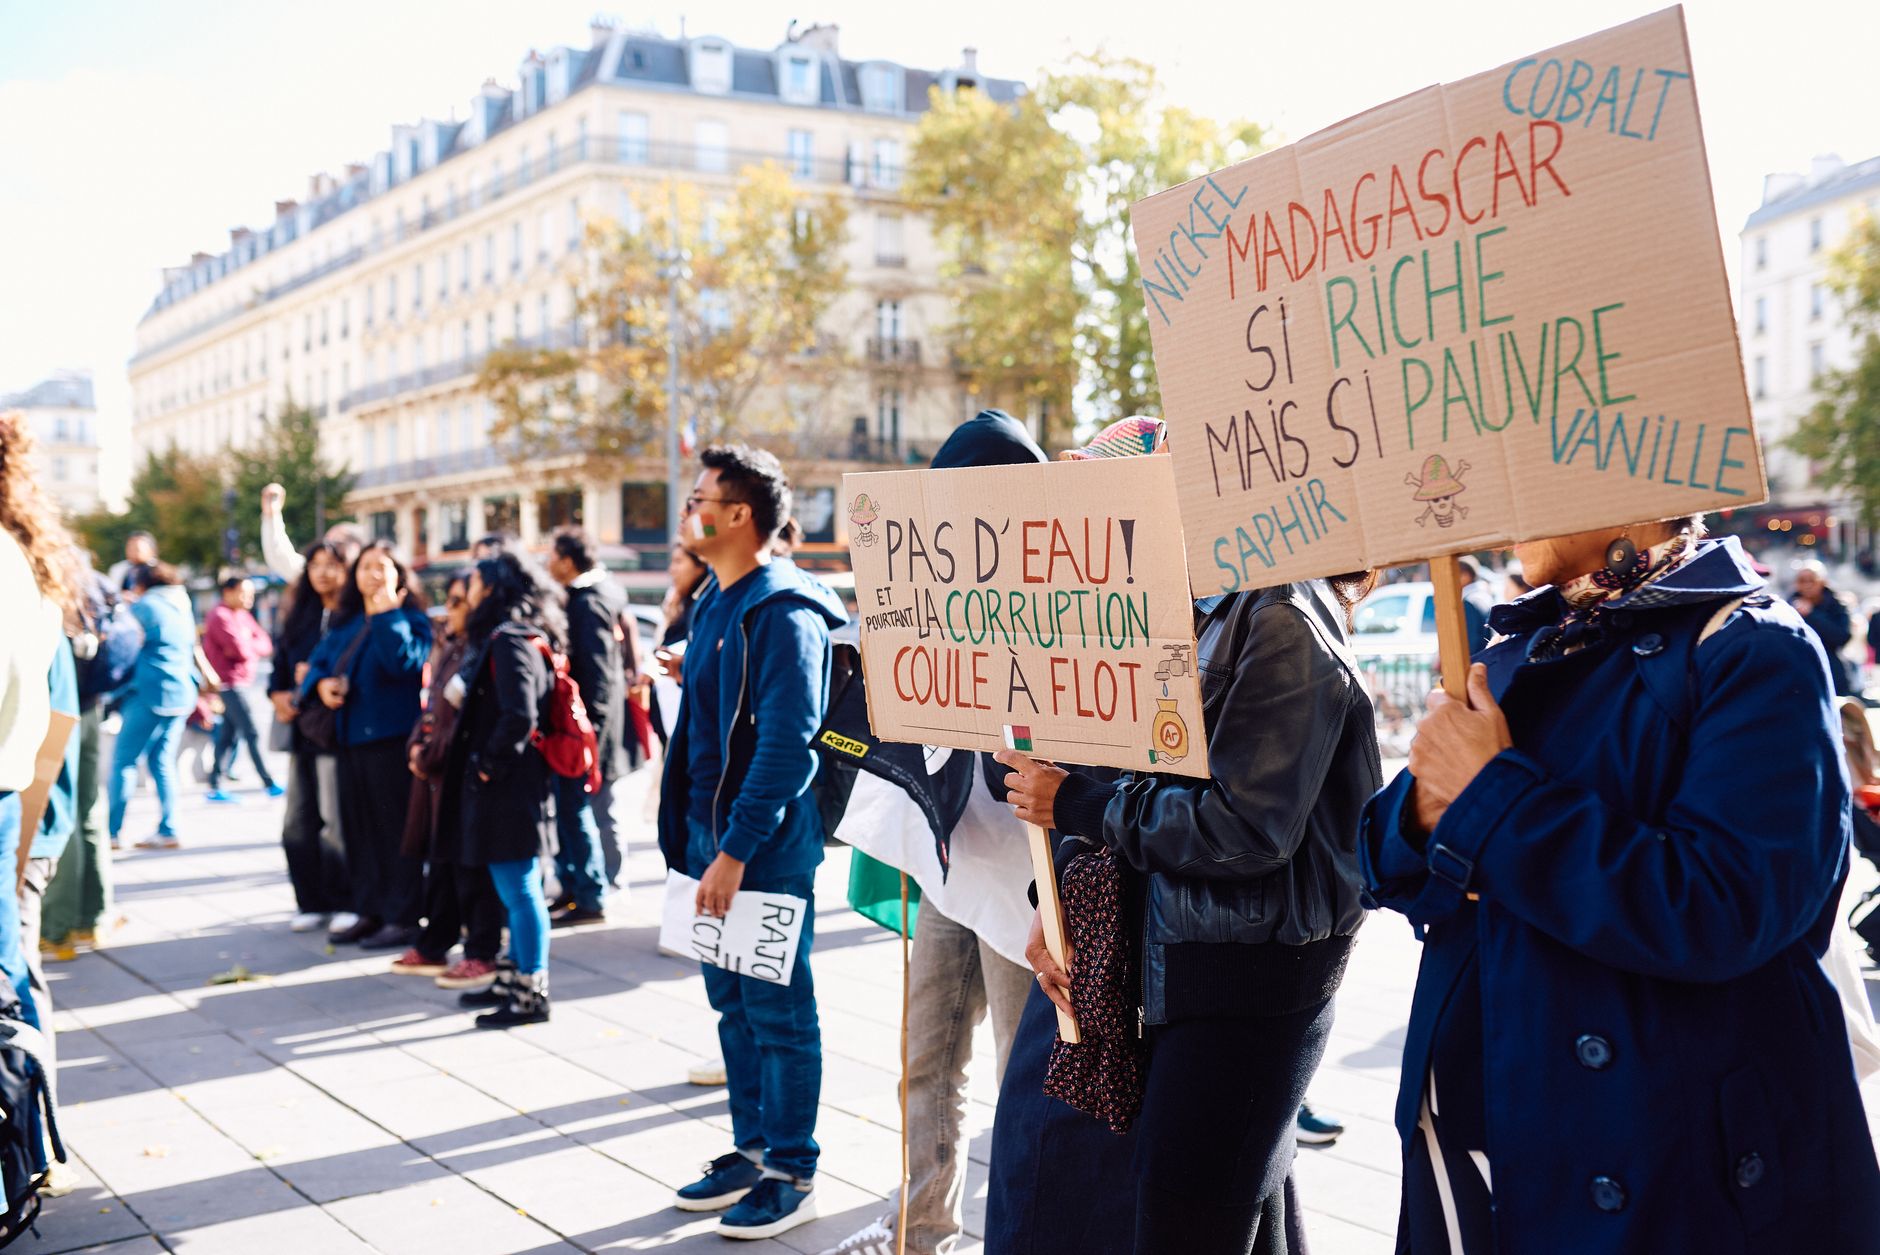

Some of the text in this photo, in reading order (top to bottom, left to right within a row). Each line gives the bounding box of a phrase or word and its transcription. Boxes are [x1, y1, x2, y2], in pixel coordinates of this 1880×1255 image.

[1502, 57, 1690, 141] COBALT
[1225, 120, 1572, 300] MADAGASCAR
[1402, 302, 1637, 451] PAUVRE
[886, 517, 955, 584] PAS
[866, 607, 914, 632] POURTANT
[915, 588, 945, 640] LA
[876, 587, 892, 607] ET
[894, 645, 1141, 722] COULE À FLOT
[826, 732, 864, 754] kana
[1164, 728, 1177, 741] Ar
[751, 902, 795, 981] RAJO
